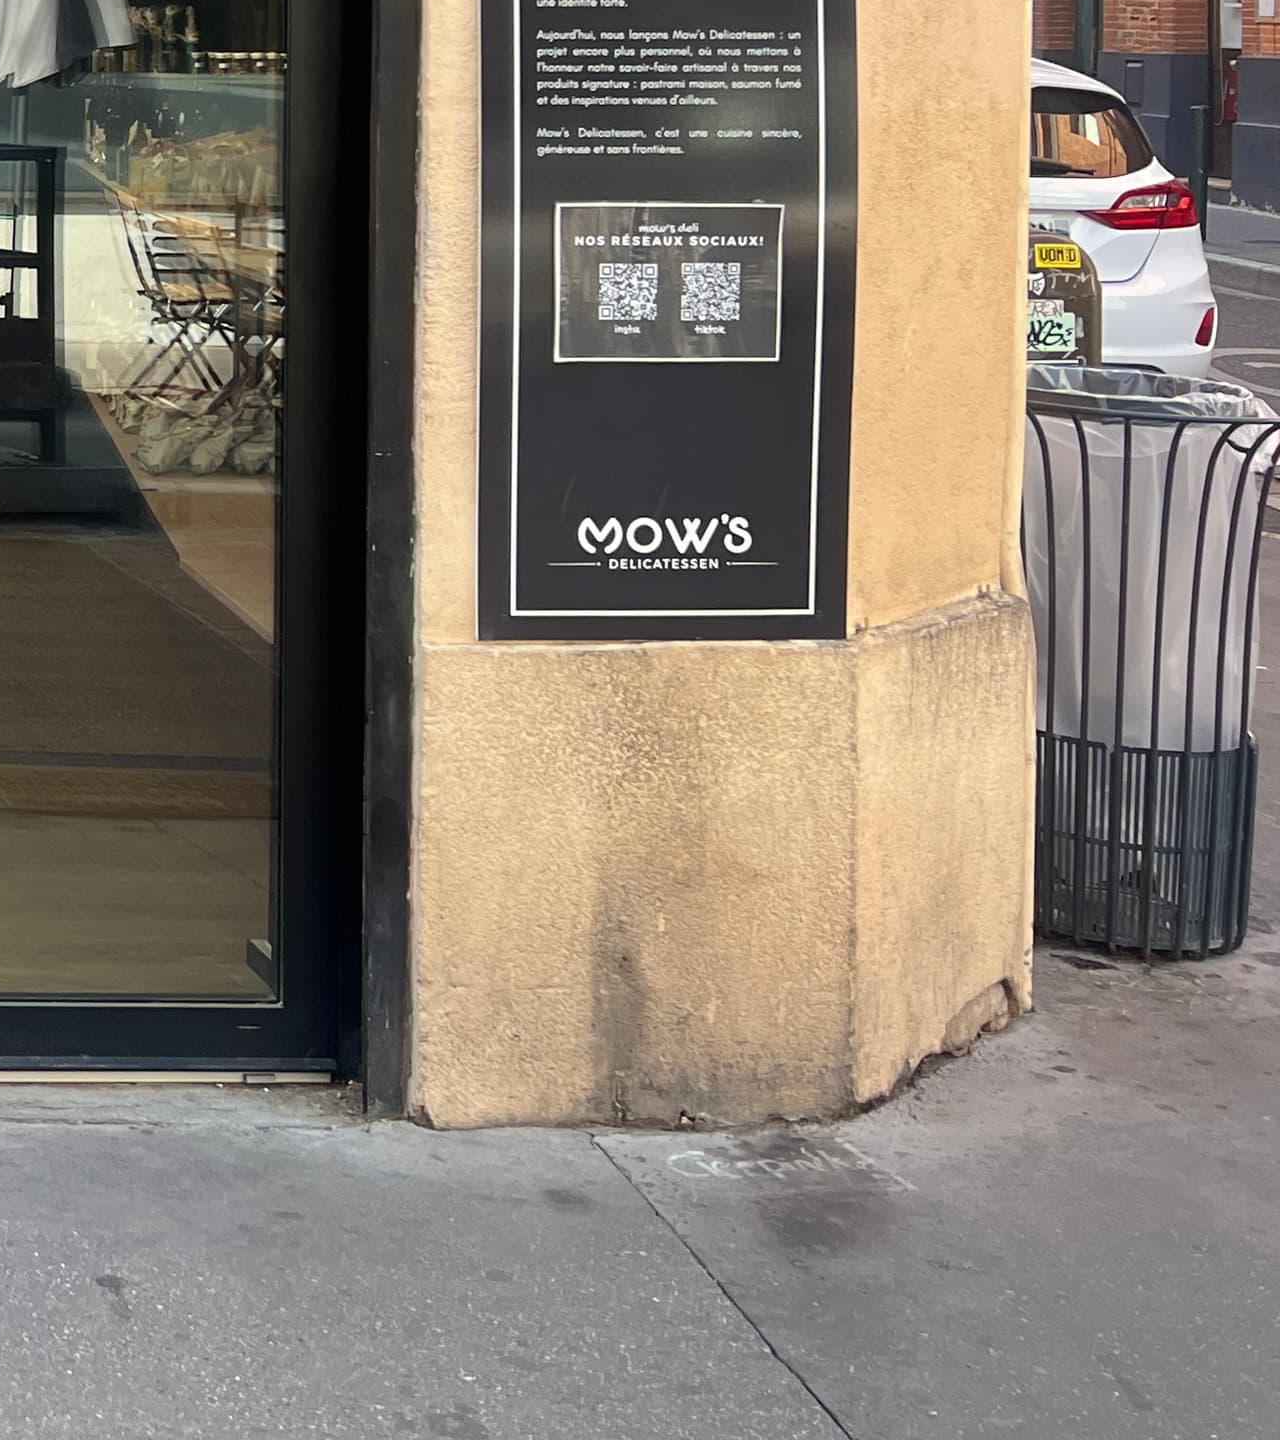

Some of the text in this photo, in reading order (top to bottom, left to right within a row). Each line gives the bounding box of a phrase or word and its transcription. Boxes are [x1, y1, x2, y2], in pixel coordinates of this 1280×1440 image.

[536, 126, 803, 140] Mow's Delicatessen, c'est une cuisine sincère,
[536, 142, 685, 157] généreuse et sans frontières.
[573, 234, 764, 248] NOS RÉSEAUX SOCIAUX!
[577, 513, 753, 555] MOW'S
[608, 558, 720, 570] DELICATESSEN
